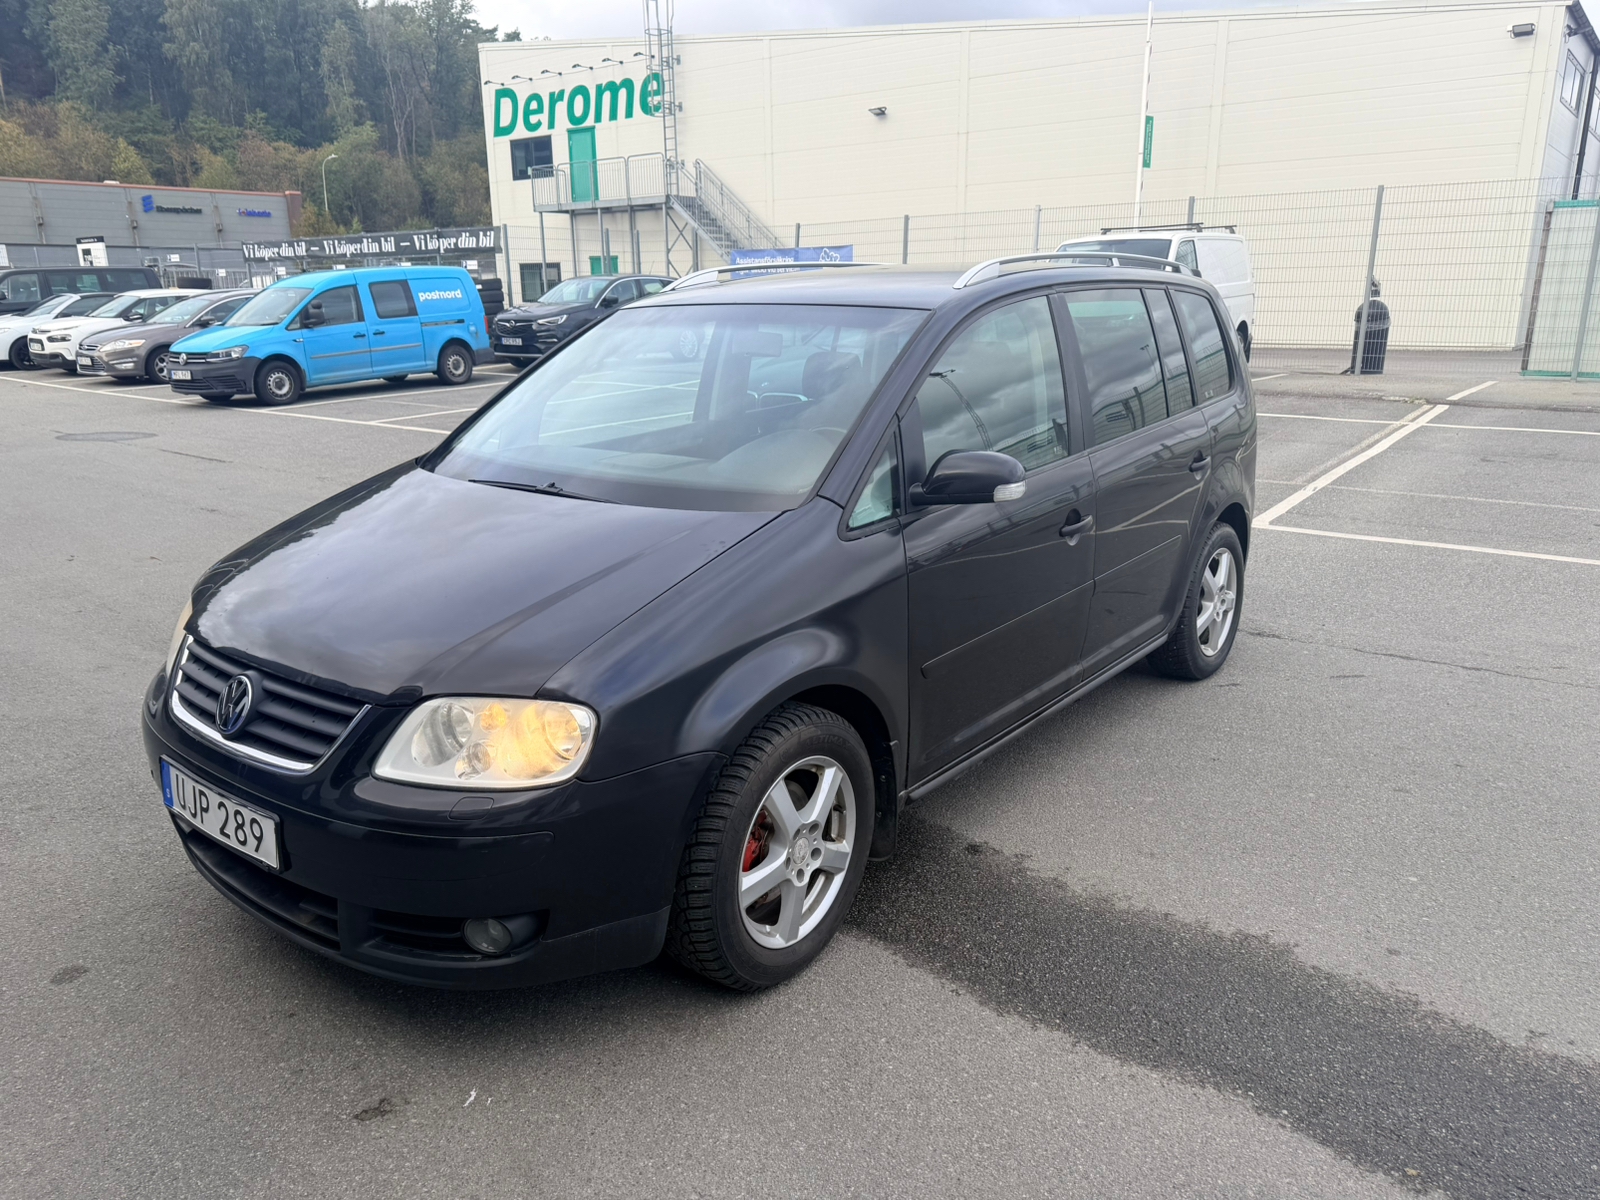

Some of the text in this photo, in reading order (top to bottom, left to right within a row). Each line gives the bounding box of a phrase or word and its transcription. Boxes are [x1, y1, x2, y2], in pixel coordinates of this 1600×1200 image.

[494, 72, 664, 138] Derome
[242, 245, 254, 258] Vi
[254, 244, 279, 261] köper
[279, 242, 295, 257] din
[294, 241, 307, 256] bil
[323, 240, 334, 255] Vi
[334, 239, 361, 257] köper
[361, 238, 380, 253] din
[380, 236, 396, 252] bil
[413, 234, 426, 251] Vi
[426, 234, 457, 254] köper
[457, 231, 477, 248] din
[479, 230, 495, 248] bil
[418, 288, 462, 302] postnord
[175, 773, 264, 853] UJP 289
